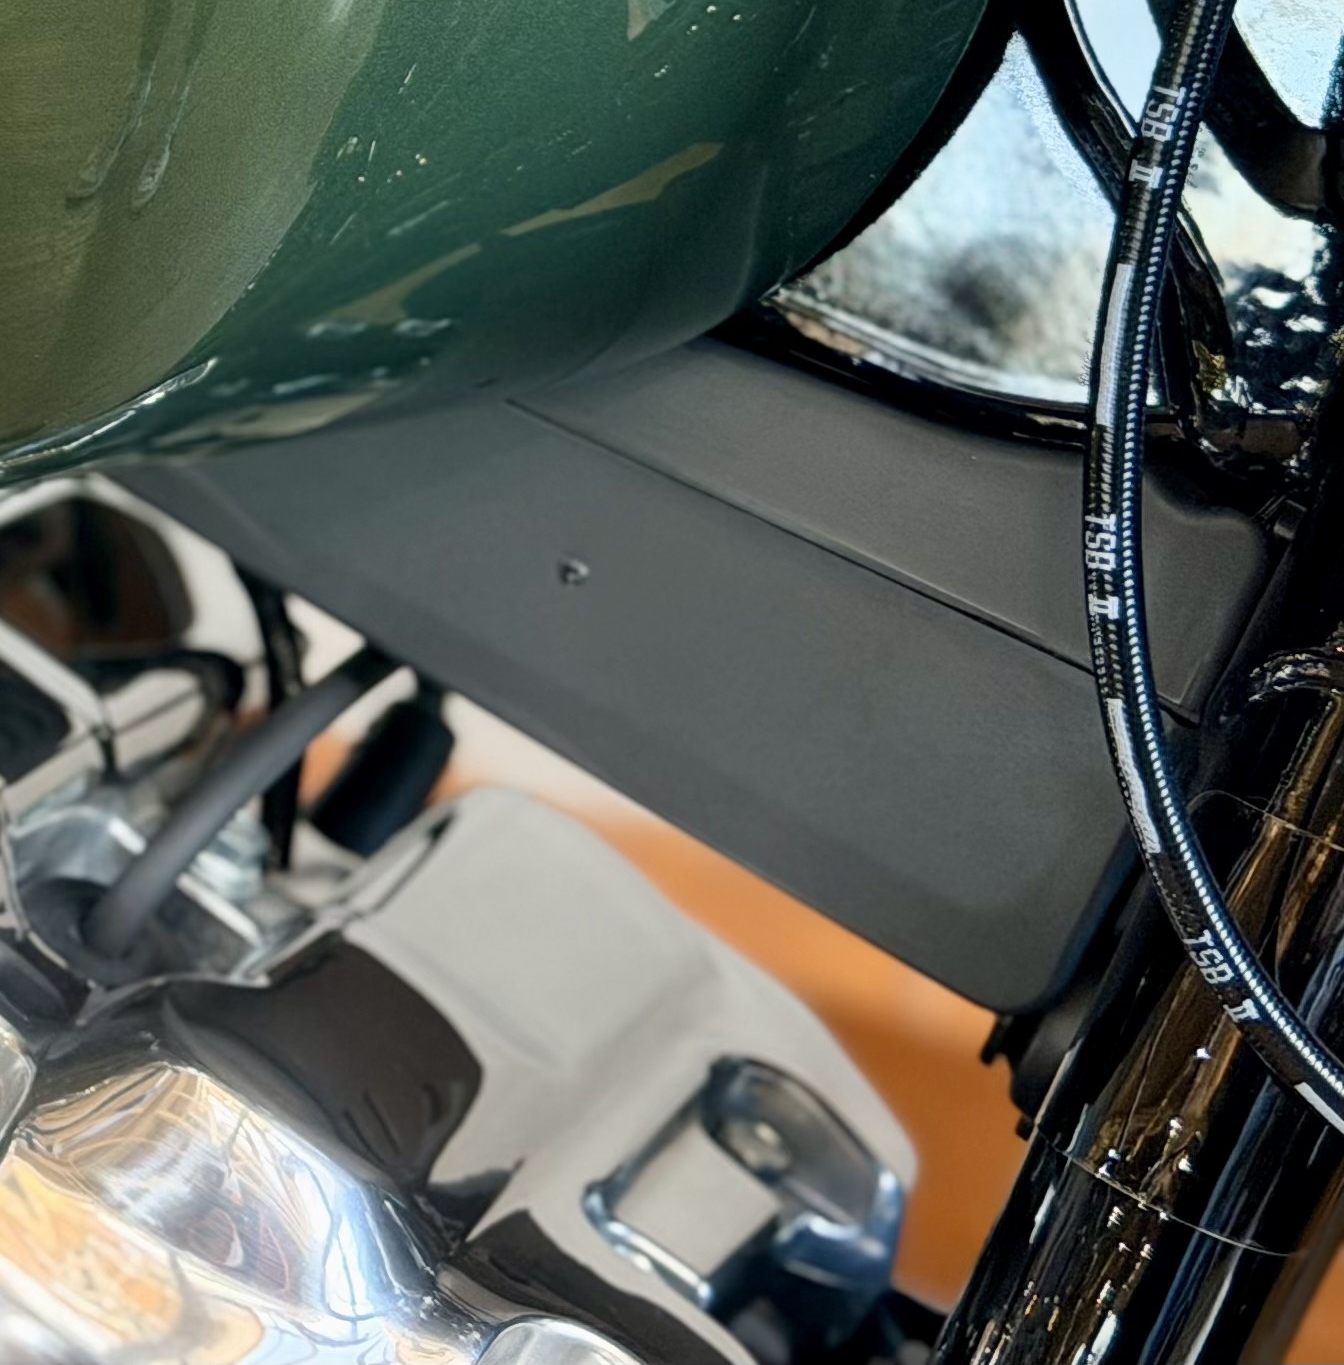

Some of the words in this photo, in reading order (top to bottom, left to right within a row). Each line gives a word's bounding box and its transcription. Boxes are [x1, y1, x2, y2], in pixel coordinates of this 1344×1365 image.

[1141, 85, 1187, 143] TSB
[1084, 513, 1117, 571] TSB
[1182, 929, 1234, 984] TSB
